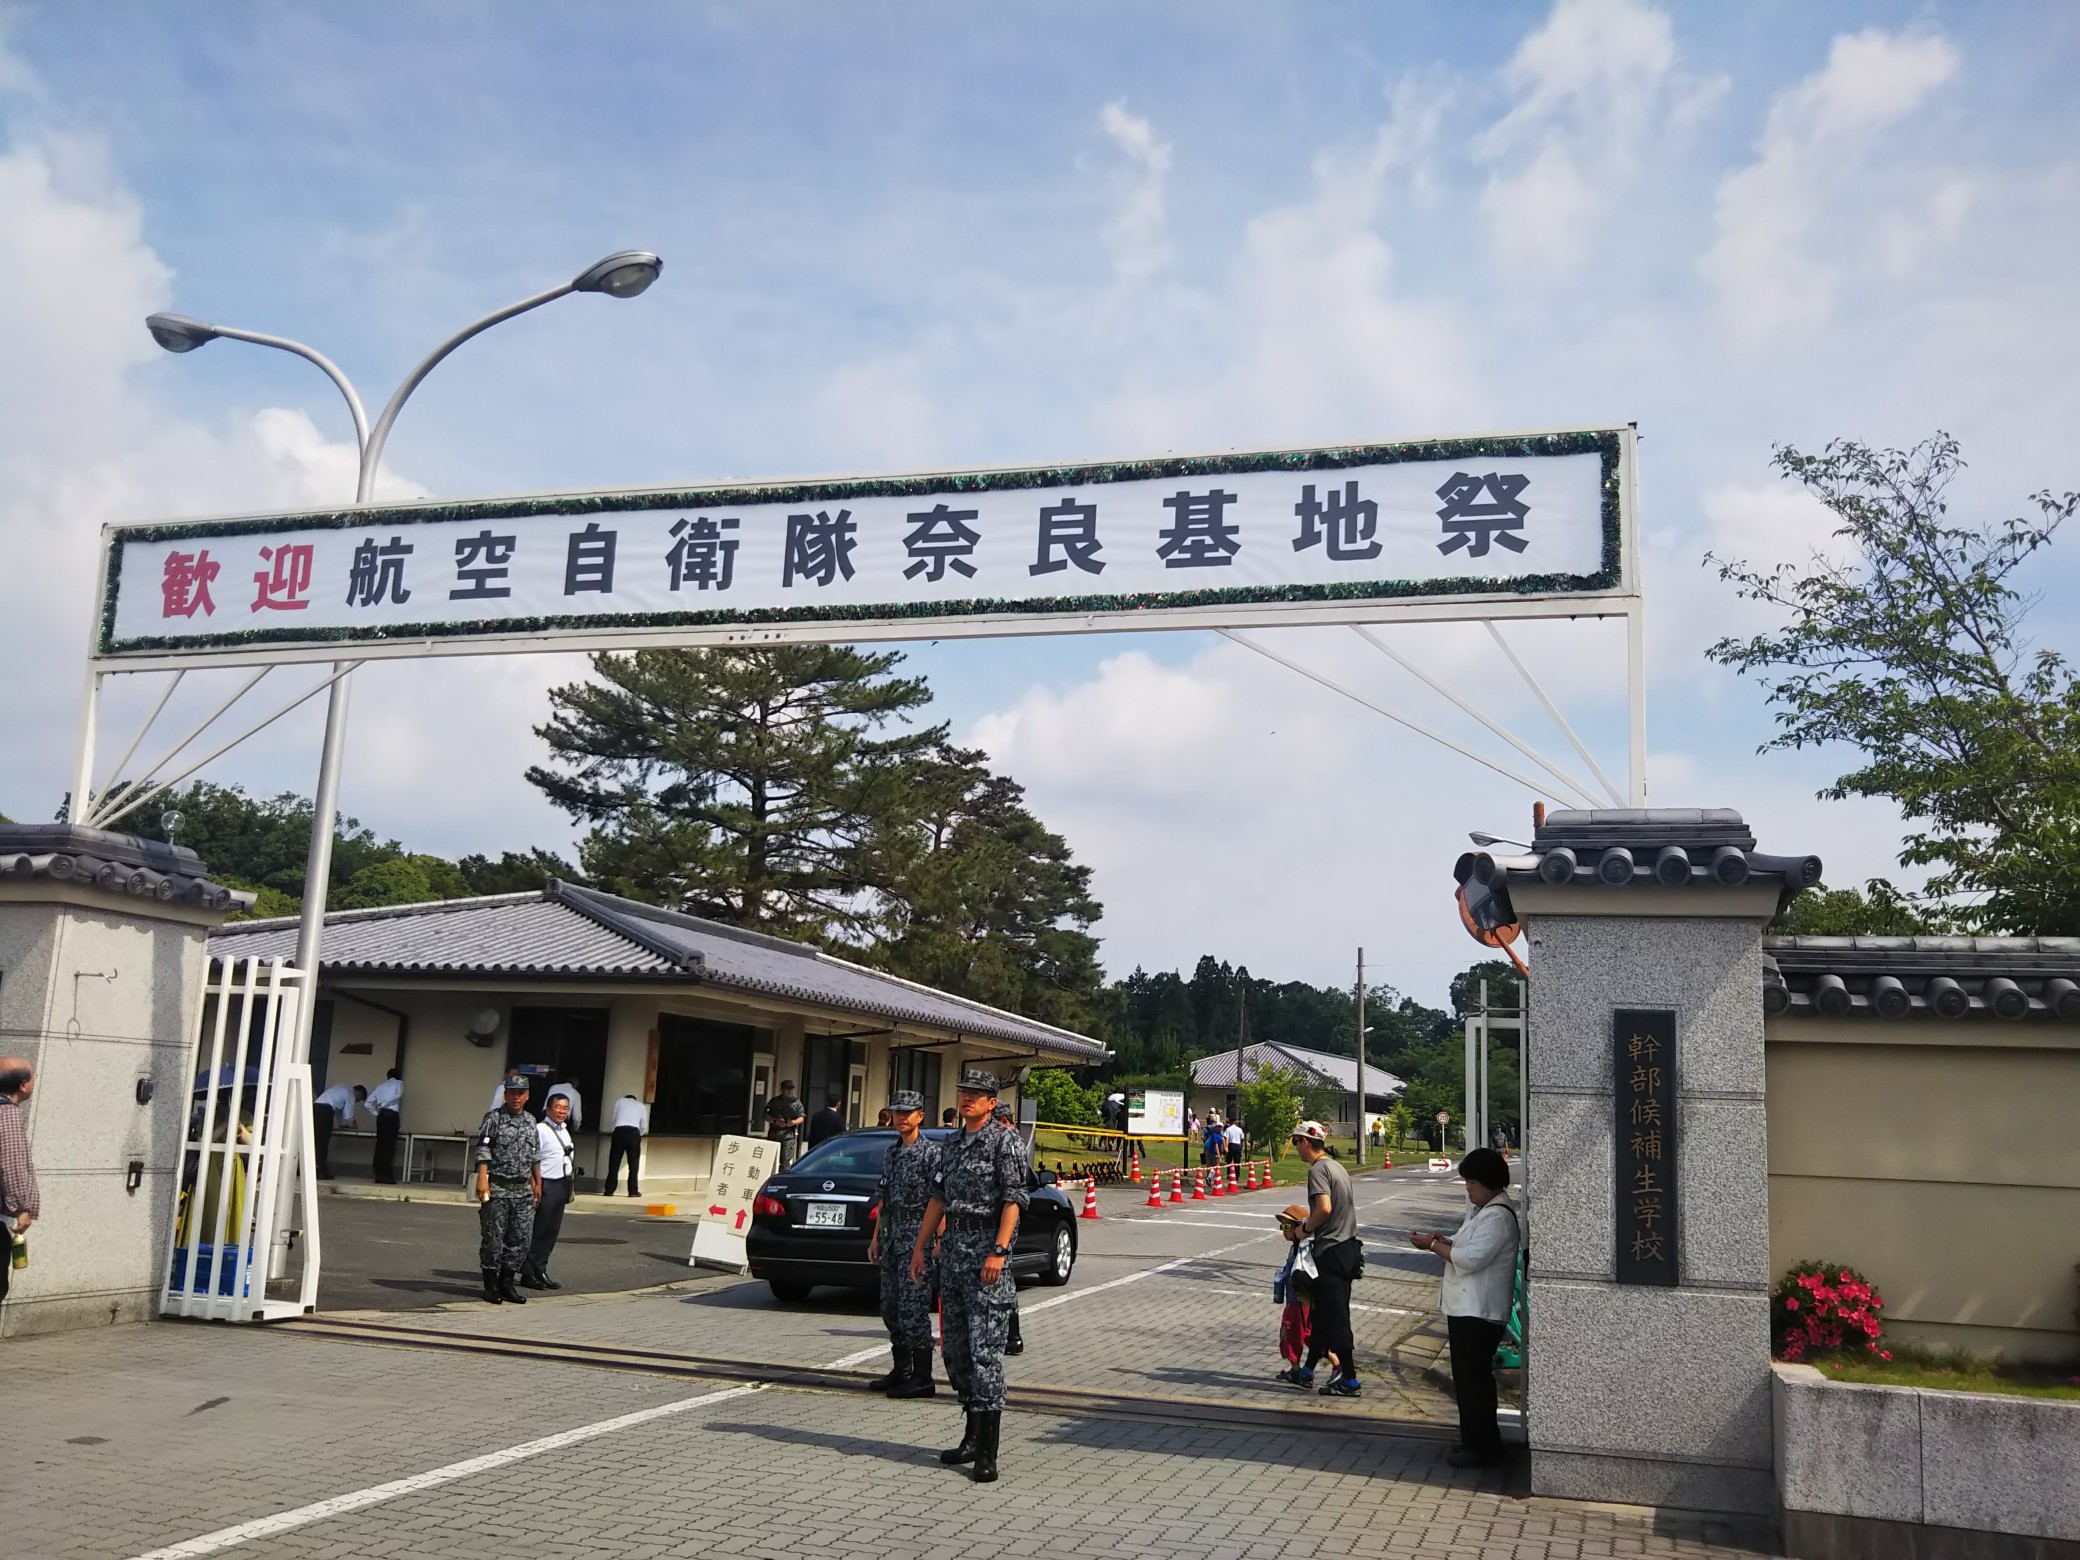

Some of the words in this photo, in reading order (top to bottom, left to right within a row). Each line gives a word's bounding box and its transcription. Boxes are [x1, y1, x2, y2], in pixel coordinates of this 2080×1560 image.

[716, 1140, 741, 1197] 歩行者
[740, 1145, 764, 1202] 自動車
[1627, 1033, 1666, 1262] 幹部候補生学校
